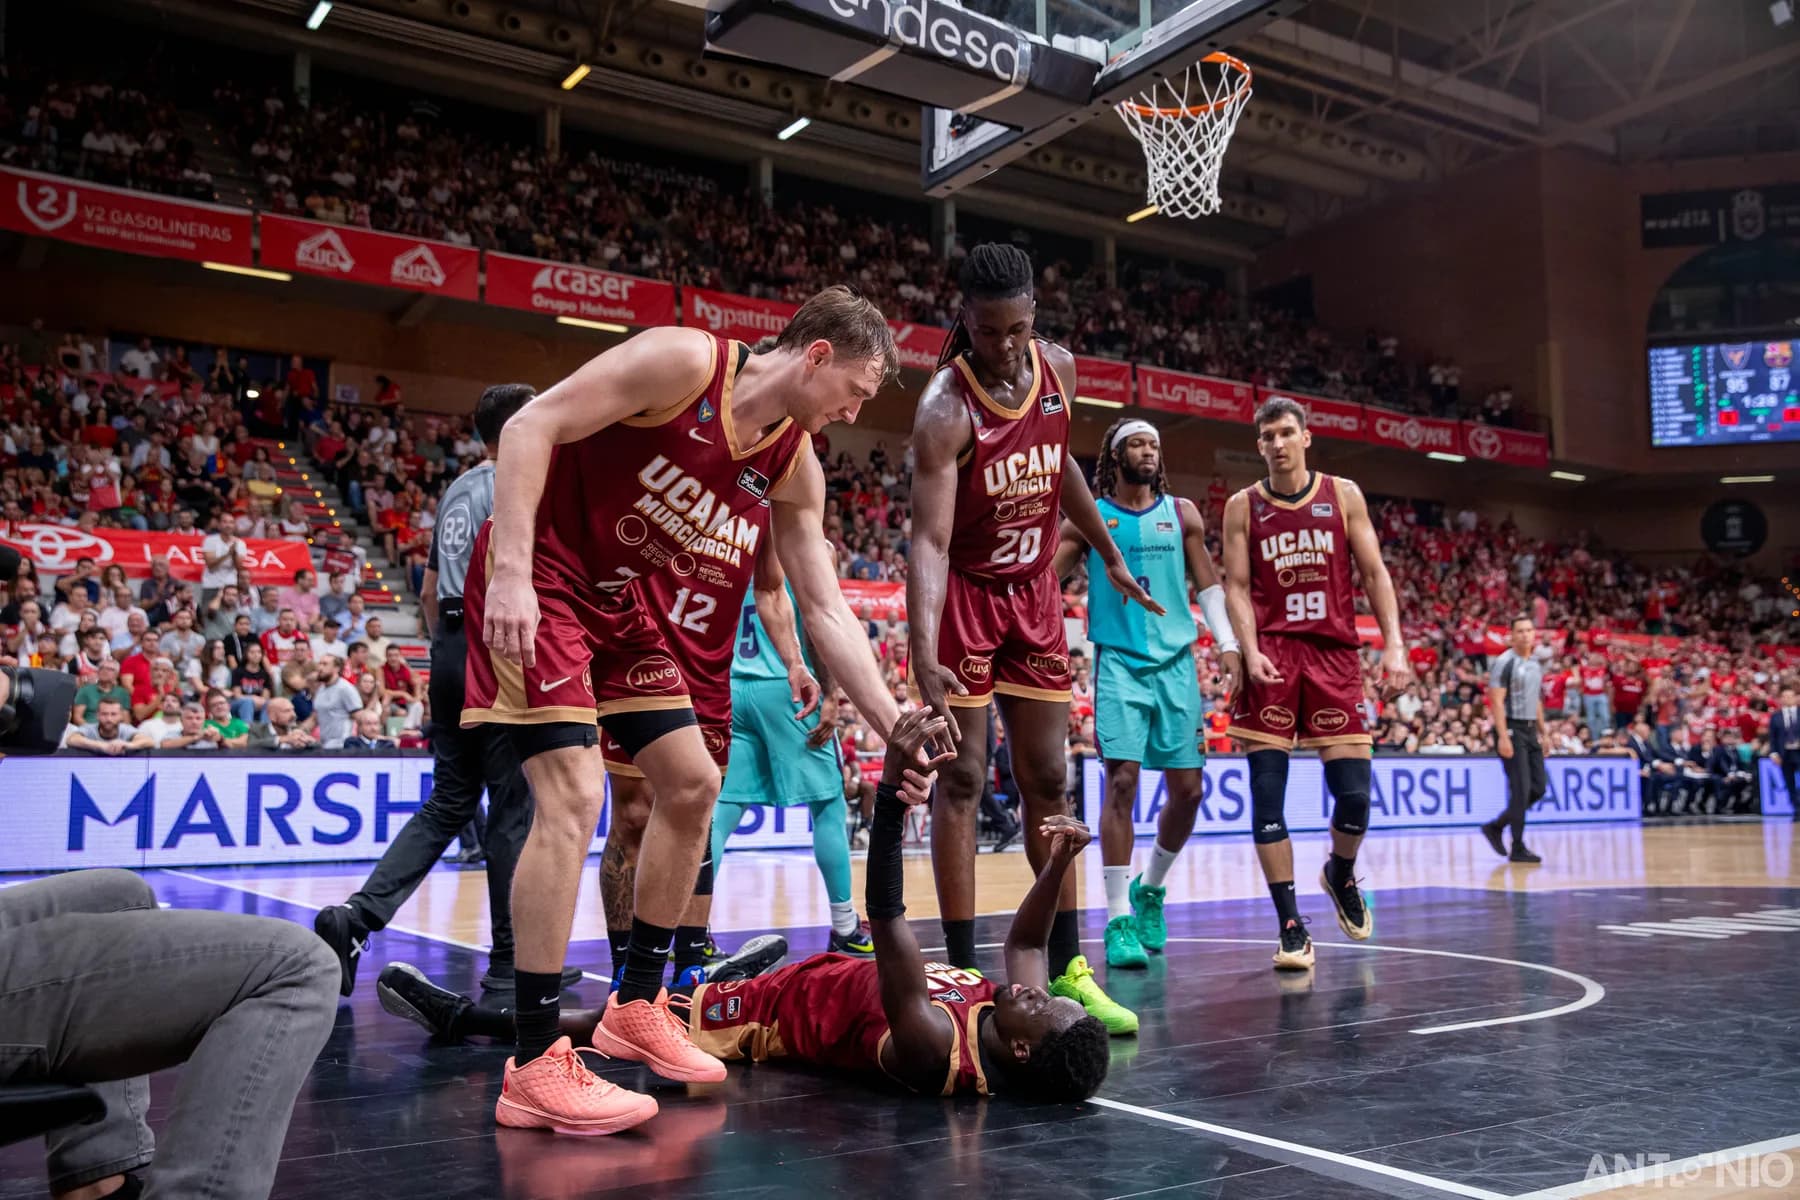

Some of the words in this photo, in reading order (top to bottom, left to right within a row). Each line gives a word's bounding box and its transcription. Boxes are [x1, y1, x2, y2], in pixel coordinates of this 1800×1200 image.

[84, 205, 105, 221] V2
[110, 208, 232, 242] GASOLINERAS
[554, 268, 635, 301] caser
[532, 293, 578, 315] Grupo
[580, 302, 636, 321] Helvetia
[694, 295, 790, 331] hgpatrim
[983, 443, 1062, 497] UCAM
[1002, 475, 1053, 498] URCIA
[443, 516, 466, 545] 82
[633, 492, 698, 548] MURCI
[690, 535, 742, 569] URCIA
[990, 527, 1042, 564] 20
[1260, 529, 1335, 562] UCAM
[1274, 551, 1327, 572] MURCIA
[668, 586, 717, 635] 12
[1286, 591, 1327, 622] 99
[635, 667, 677, 685] Juver
[964, 661, 989, 674] Juv
[1264, 710, 1291, 724] Juver
[1317, 714, 1345, 726] Juver
[1322, 768, 1471, 818] ARSH
[1528, 767, 1630, 813] ARSH
[67, 771, 434, 851] MARSH
